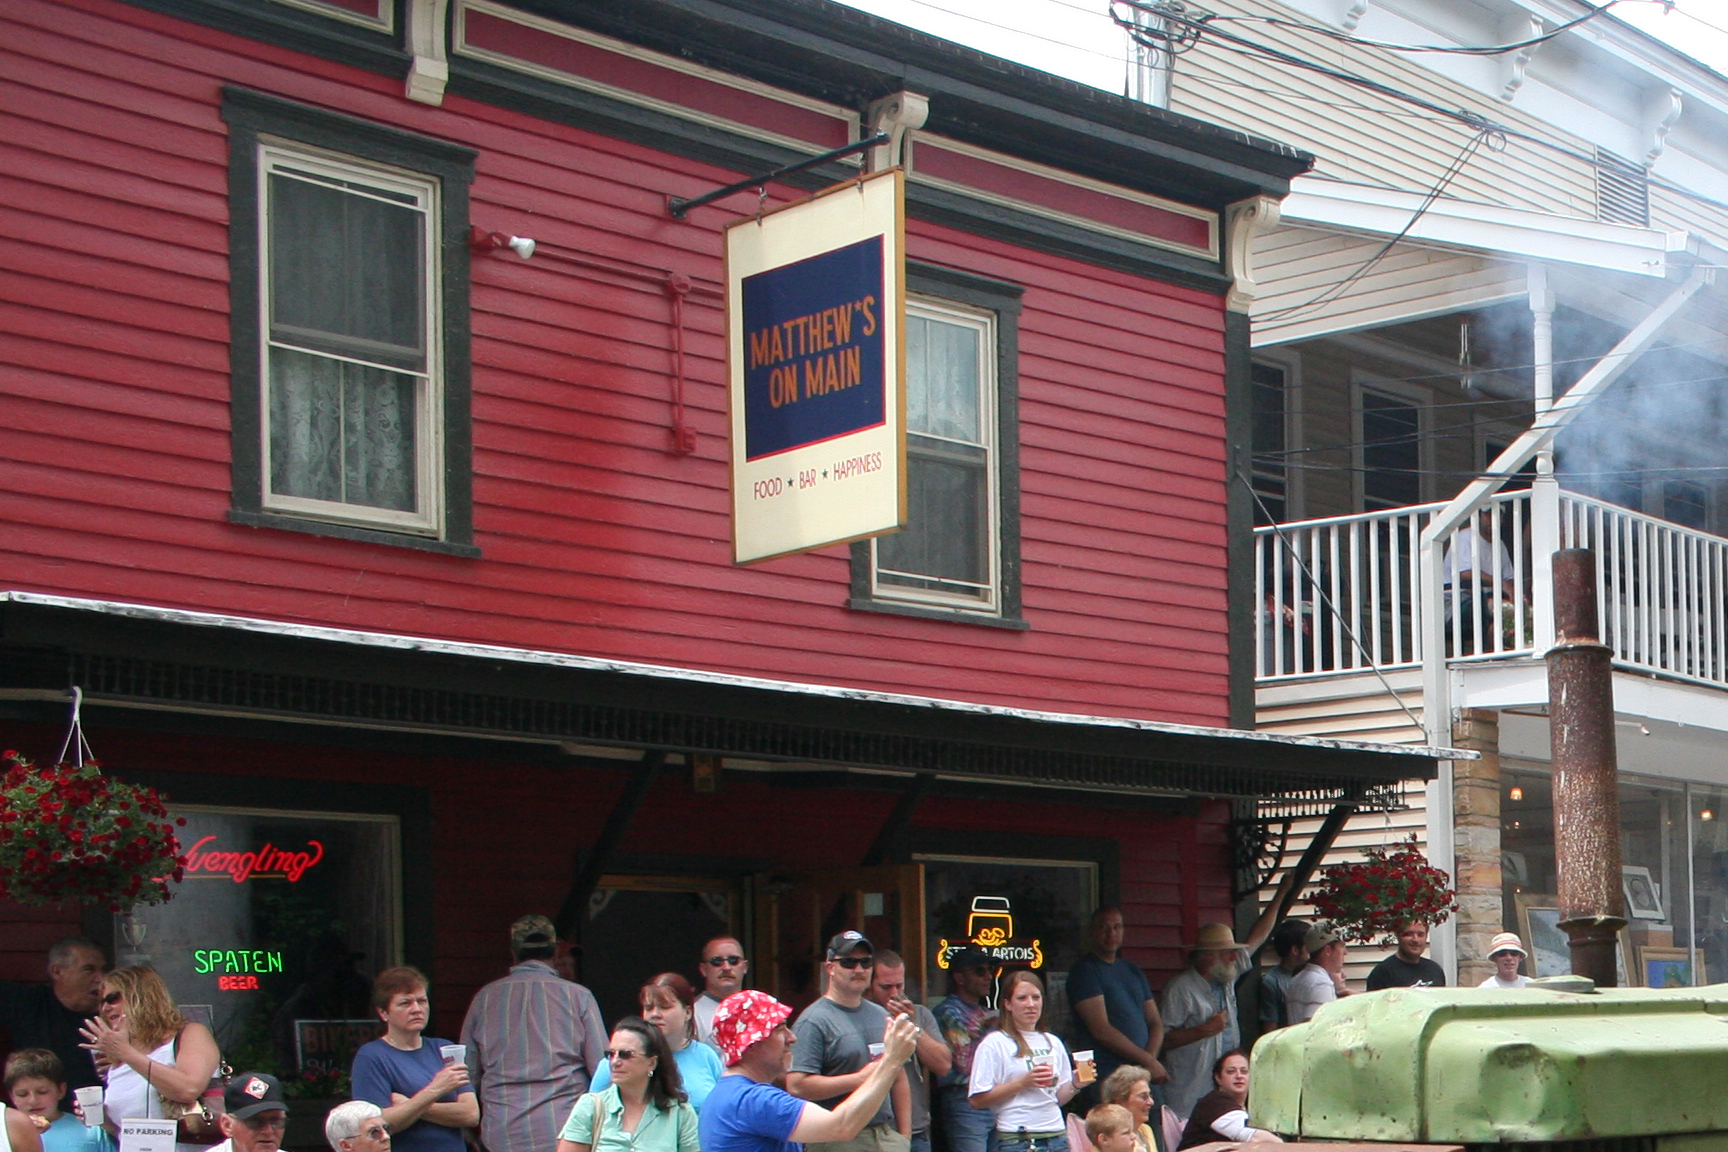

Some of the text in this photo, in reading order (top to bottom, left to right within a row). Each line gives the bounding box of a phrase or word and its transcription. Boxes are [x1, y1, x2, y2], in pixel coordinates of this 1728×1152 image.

[750, 295, 876, 370] MATTHEW'S
[769, 345, 861, 408] ON MAIN
[754, 452, 882, 500] FOOD BAR HAPPINESS
[183, 835, 325, 883] uengling
[194, 949, 283, 974] SPATEN
[992, 947, 1035, 960] ARTOIS
[218, 975, 260, 992] BEER
[123, 1128, 174, 1136] NO PARKING
